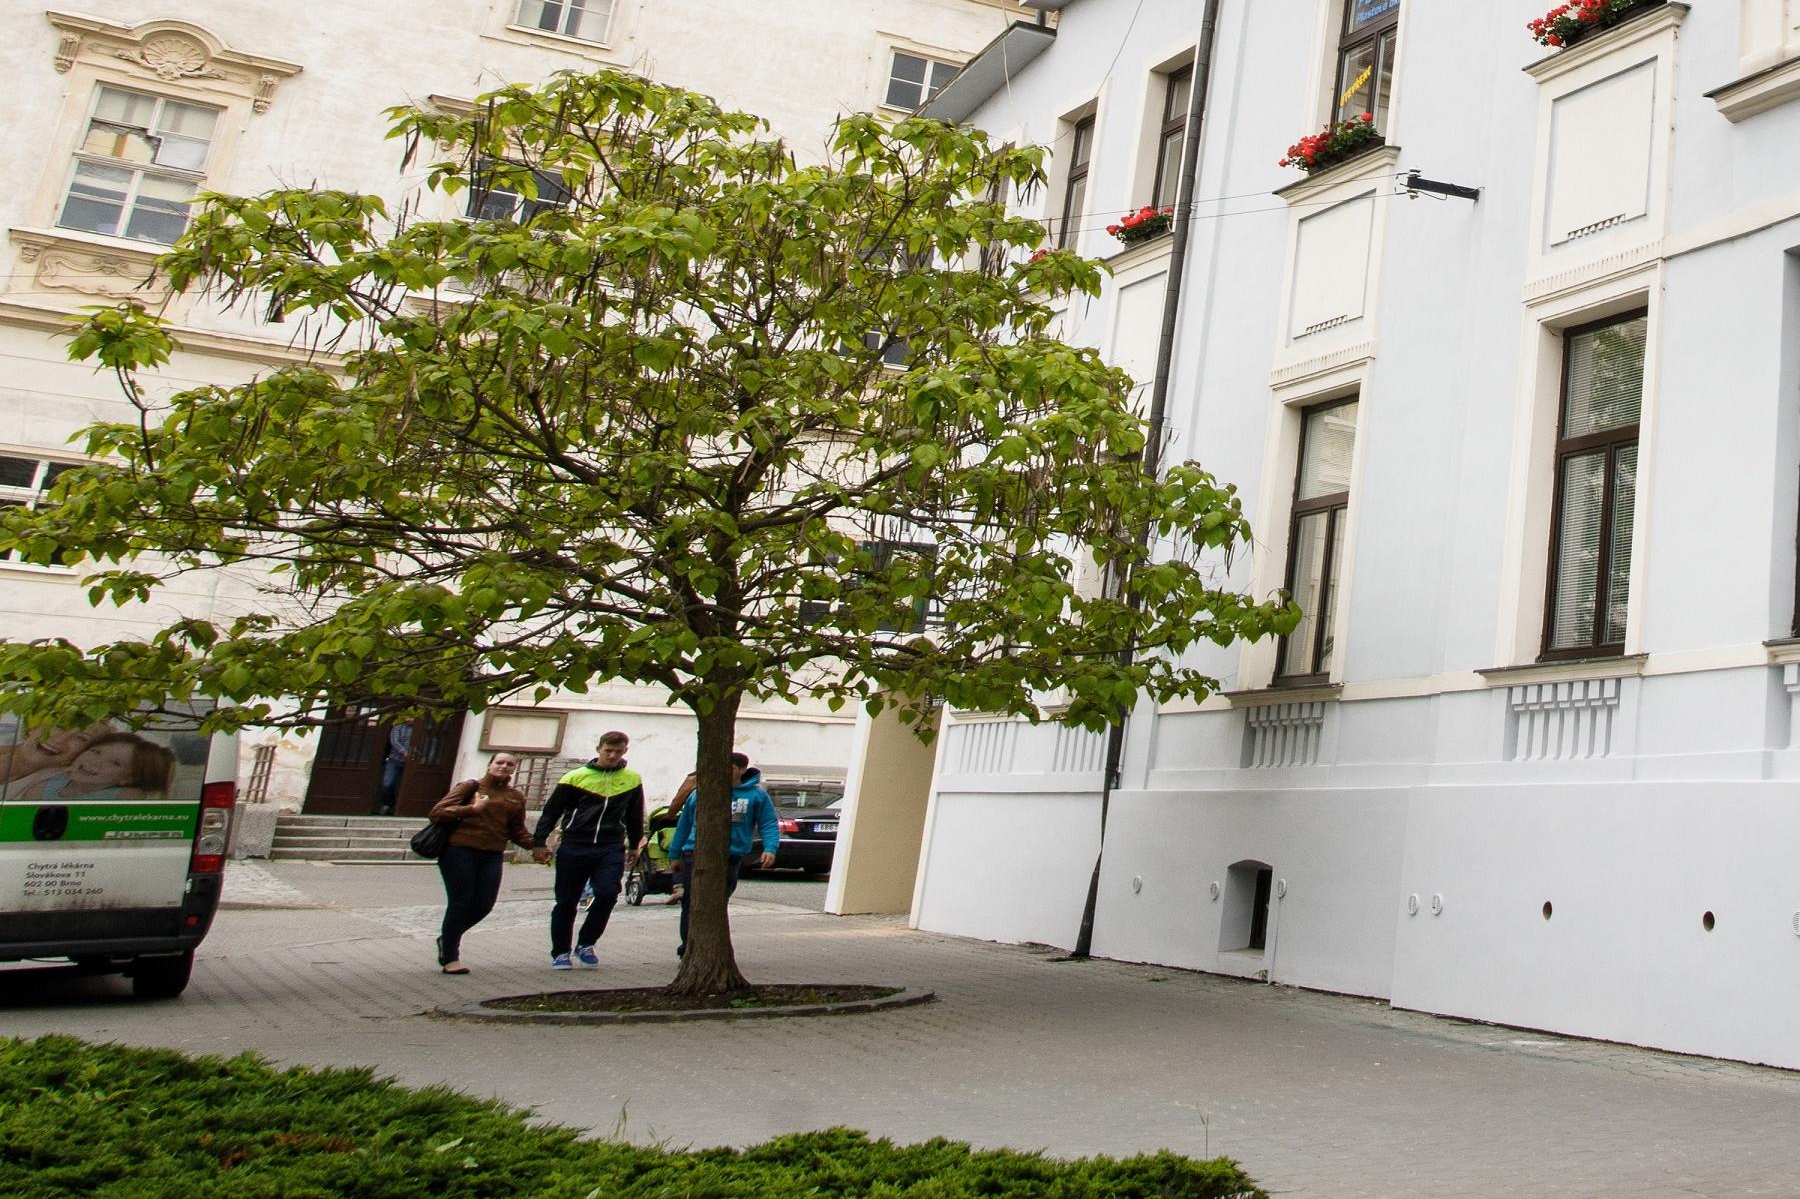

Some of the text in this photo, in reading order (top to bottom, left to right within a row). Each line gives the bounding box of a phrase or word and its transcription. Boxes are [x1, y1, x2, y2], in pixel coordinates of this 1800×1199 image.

[79, 813, 189, 823] www.chytralekarna.eu
[27, 862, 58, 871] Chytrá
[25, 871, 72, 879] Slovákova
